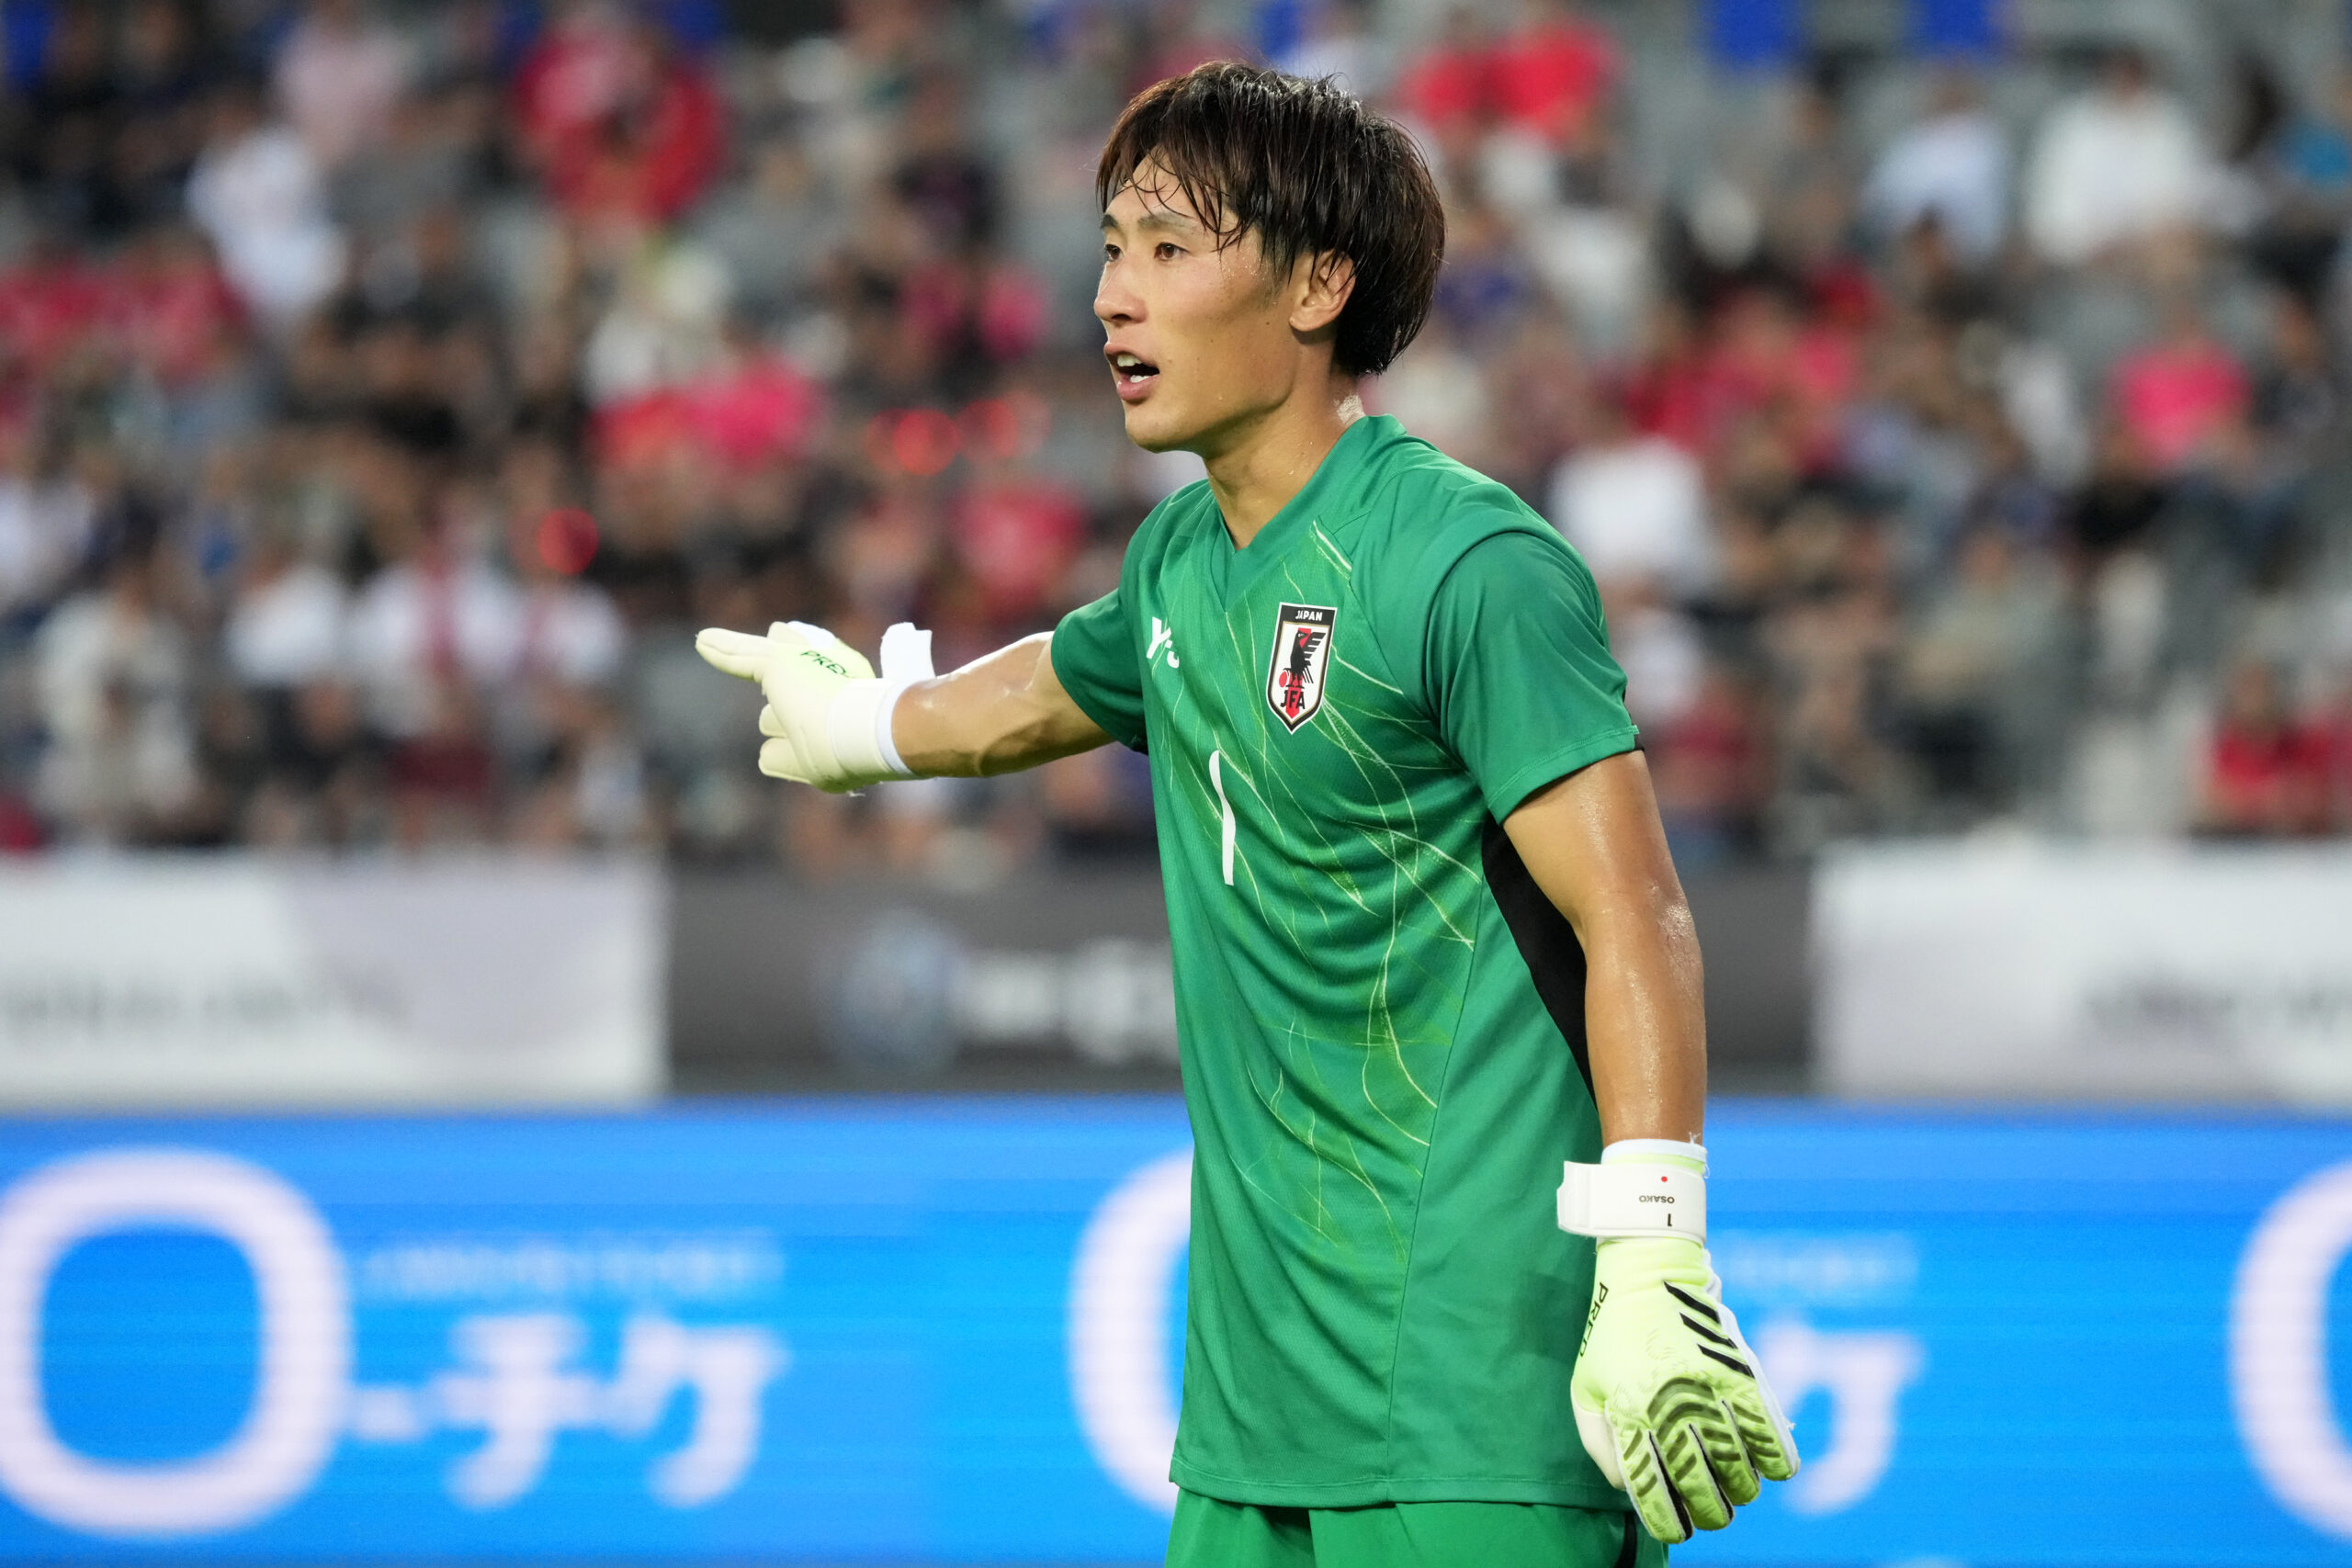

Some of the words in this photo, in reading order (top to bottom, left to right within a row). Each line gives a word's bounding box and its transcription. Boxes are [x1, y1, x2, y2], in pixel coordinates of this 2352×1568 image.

[1295, 610, 1323, 622] JAPAN
[1280, 690, 1306, 710] JFA
[1208, 750, 1237, 886] 1
[1638, 1195, 1675, 1204] OSAKO
[1667, 1213, 1673, 1227] 1
